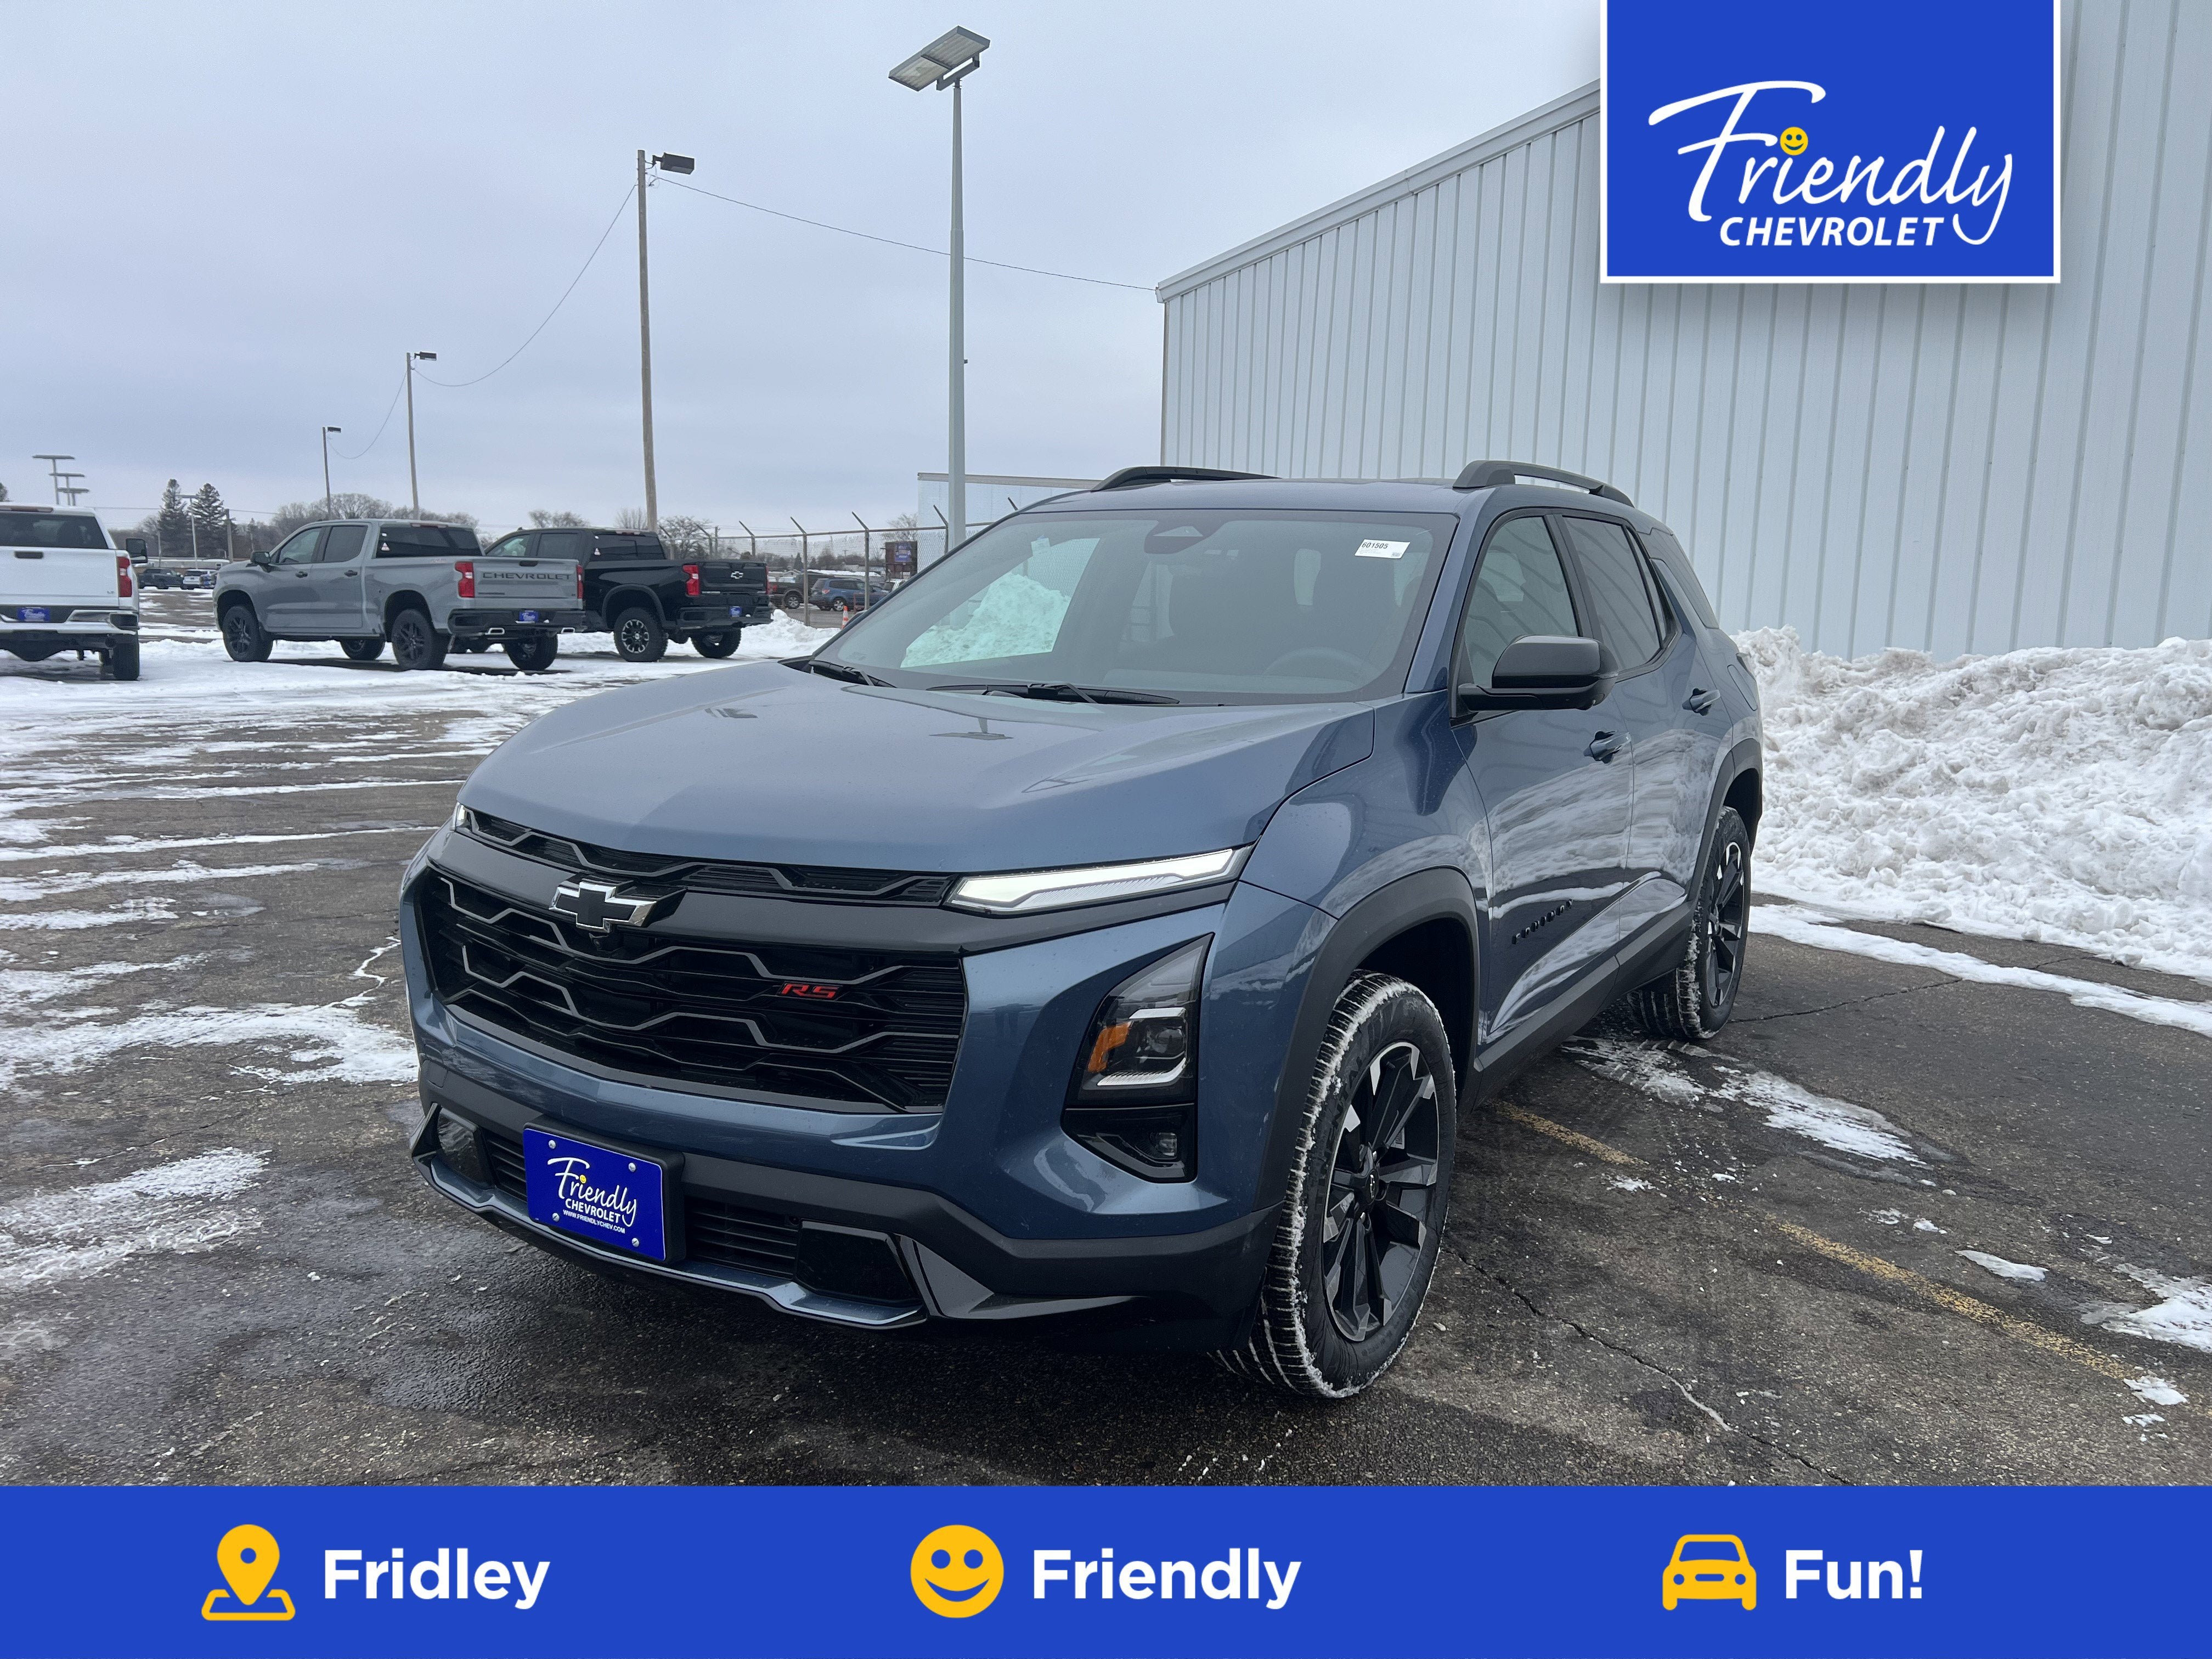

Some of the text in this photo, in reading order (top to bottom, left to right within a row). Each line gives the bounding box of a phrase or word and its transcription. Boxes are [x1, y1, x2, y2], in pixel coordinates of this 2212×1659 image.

[482, 572, 572, 580] CHEVROLET
[781, 983, 840, 998] RS
[547, 1157, 637, 1227] Friendly
[562, 1209, 626, 1234] WWW.FRIENDLYCHEV.COM
[565, 1198, 621, 1223] CHEVROLET
